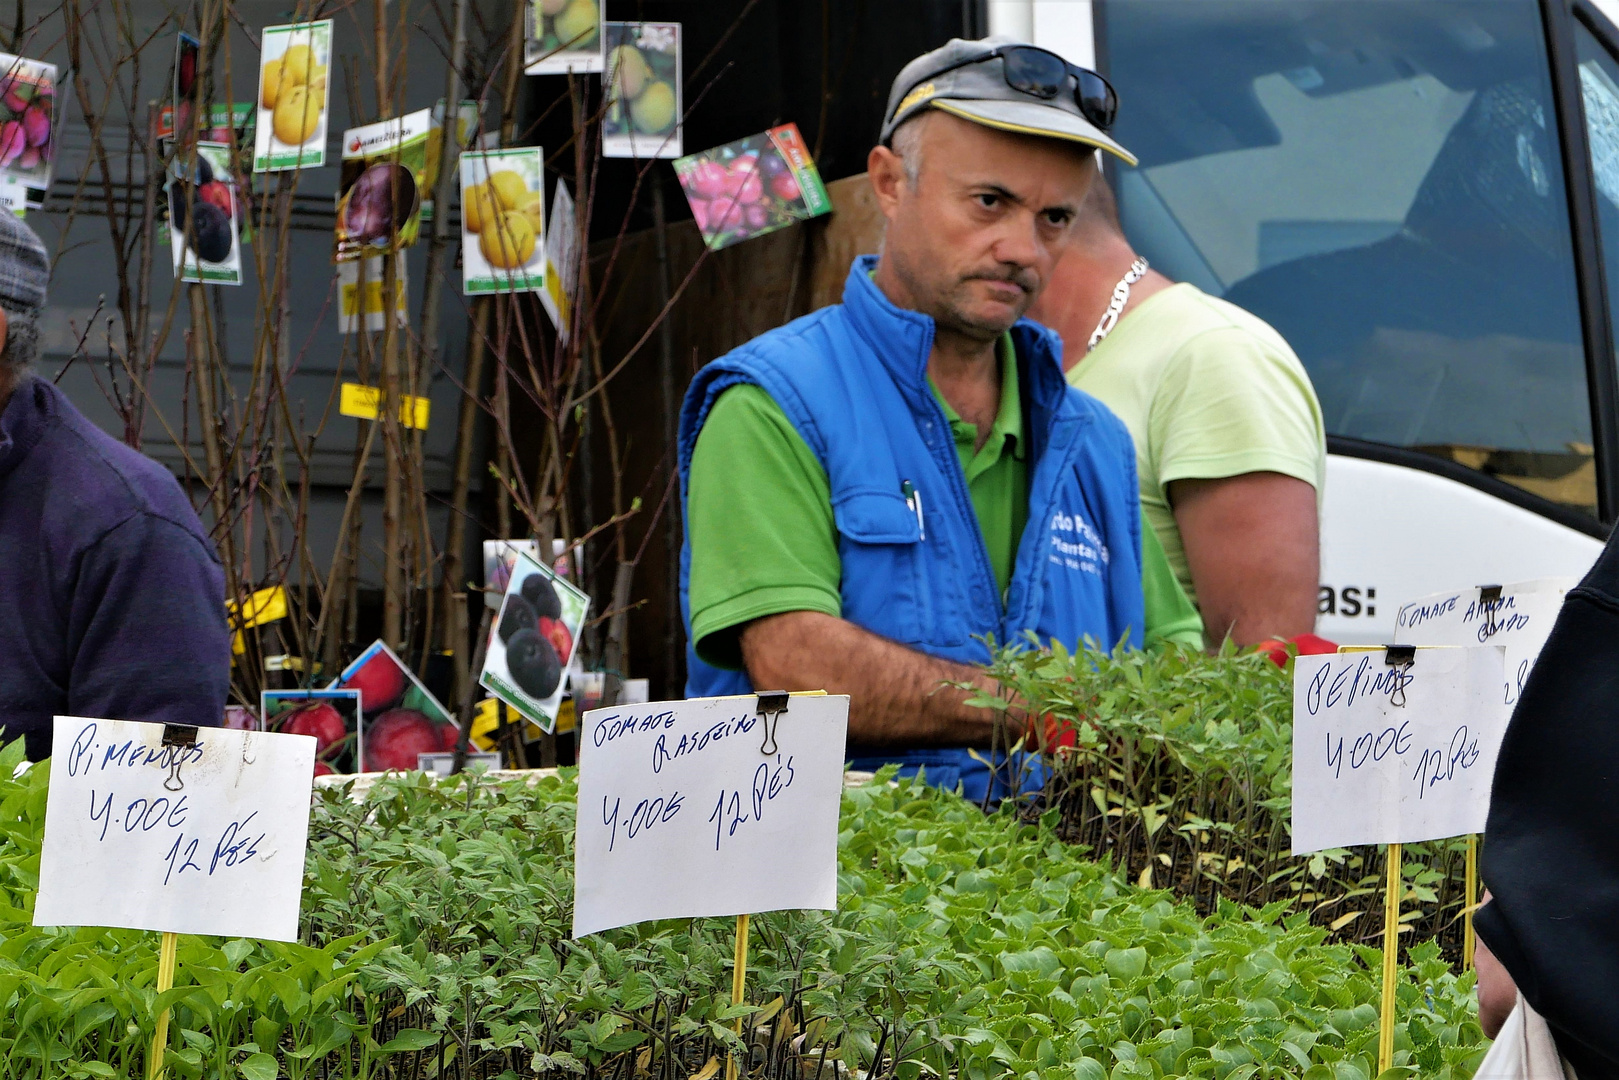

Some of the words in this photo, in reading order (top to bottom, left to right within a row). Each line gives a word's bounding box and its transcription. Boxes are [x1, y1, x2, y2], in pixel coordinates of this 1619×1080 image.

[1412, 748, 1447, 800] 12
[708, 789, 749, 851] 12
[164, 833, 201, 886] 12
